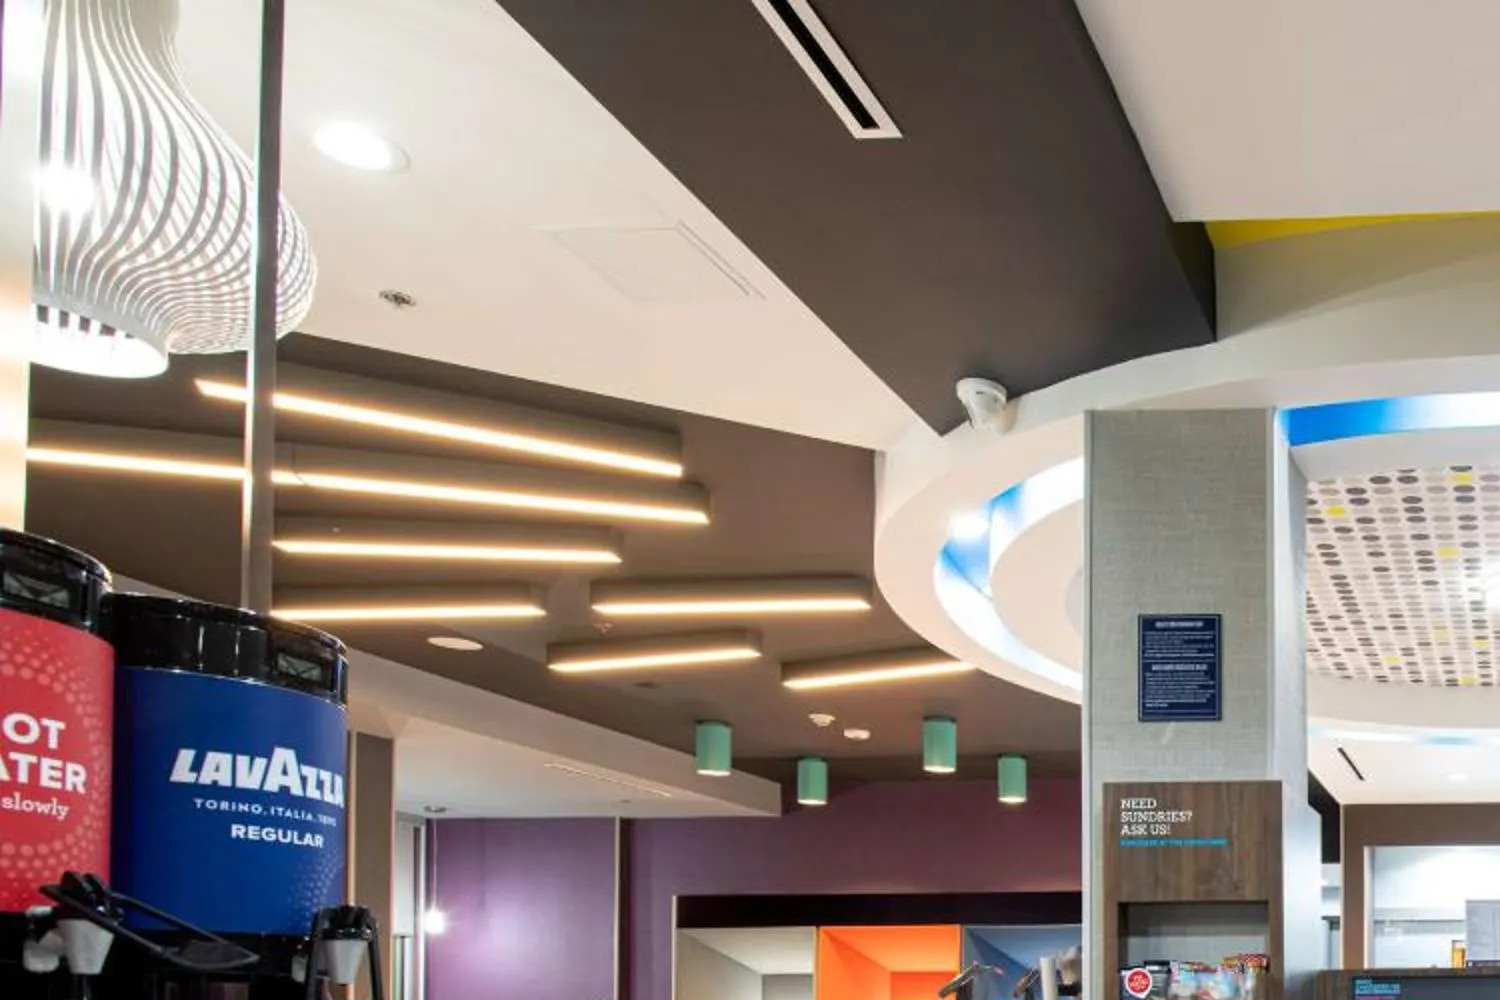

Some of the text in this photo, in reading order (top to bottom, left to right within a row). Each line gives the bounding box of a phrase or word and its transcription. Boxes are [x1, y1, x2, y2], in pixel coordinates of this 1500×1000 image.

[2, 712, 66, 750] OT
[0, 752, 86, 795] TER
[2, 791, 70, 821] slowly
[1120, 797, 1158, 809] NEED
[1120, 810, 1193, 823] SUNDRIES?
[1120, 823, 1172, 835] ASK US!
[231, 823, 325, 849] REGULAR
